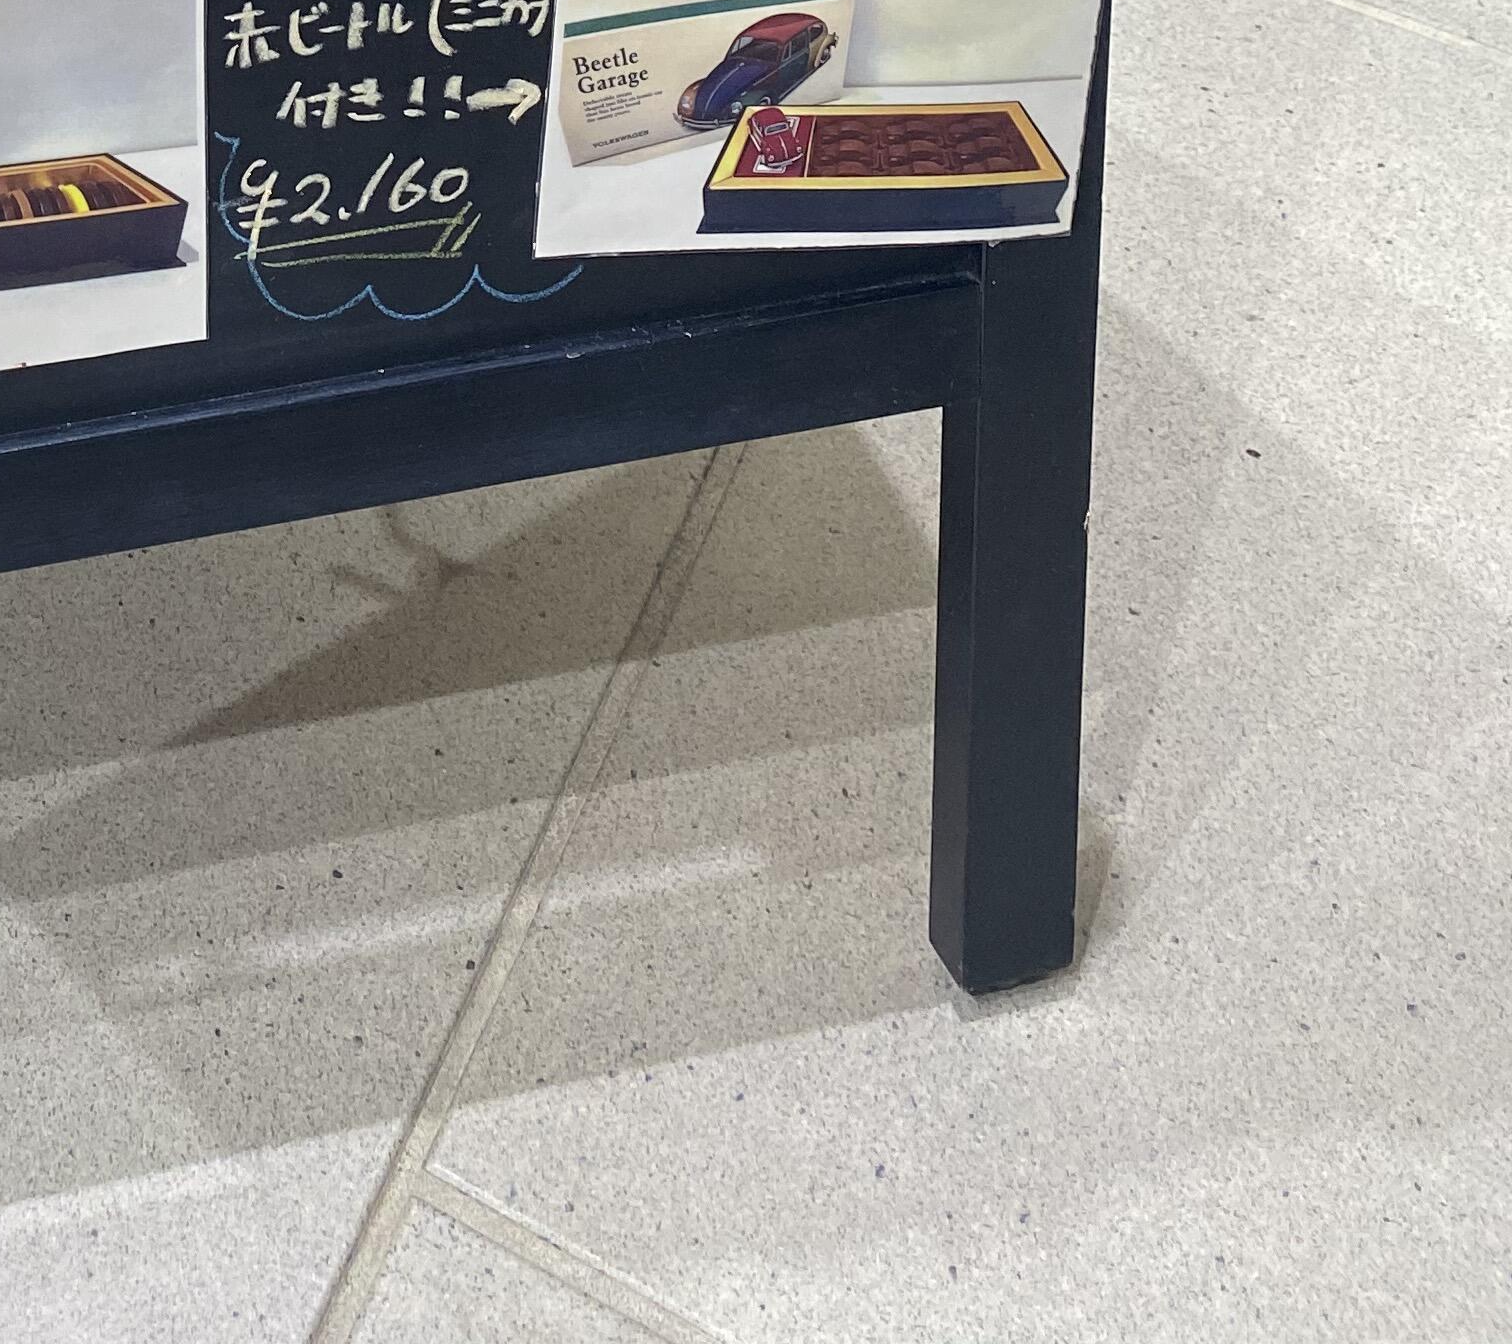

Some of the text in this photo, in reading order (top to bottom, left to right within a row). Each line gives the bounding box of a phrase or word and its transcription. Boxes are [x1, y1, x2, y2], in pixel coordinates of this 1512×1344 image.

[572, 47, 639, 75] Beetle
[577, 69, 649, 94] Garage
[592, 130, 649, 149] VOLKSWAGEN
